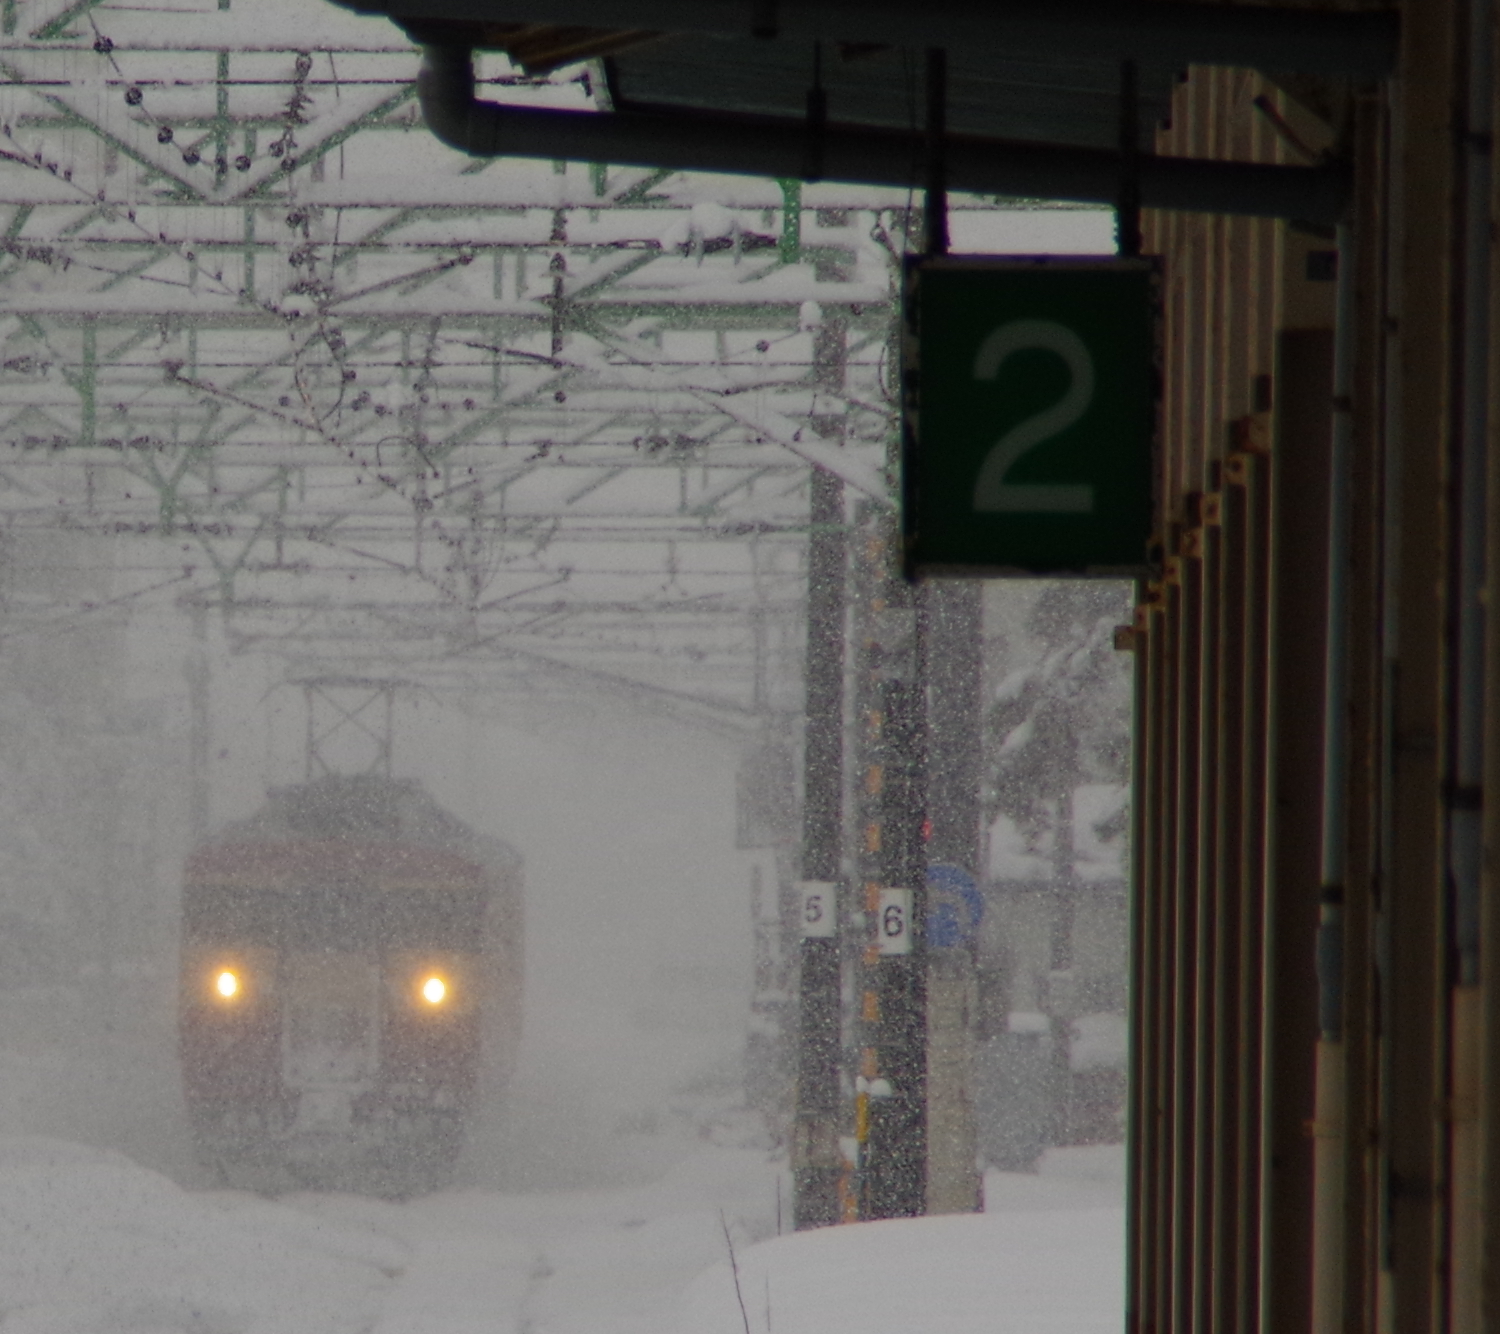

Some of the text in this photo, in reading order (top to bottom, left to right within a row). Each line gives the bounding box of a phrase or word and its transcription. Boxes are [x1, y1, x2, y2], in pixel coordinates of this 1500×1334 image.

[973, 319, 1094, 512] 2
[805, 895, 823, 923] 5
[883, 905, 904, 937] 6
